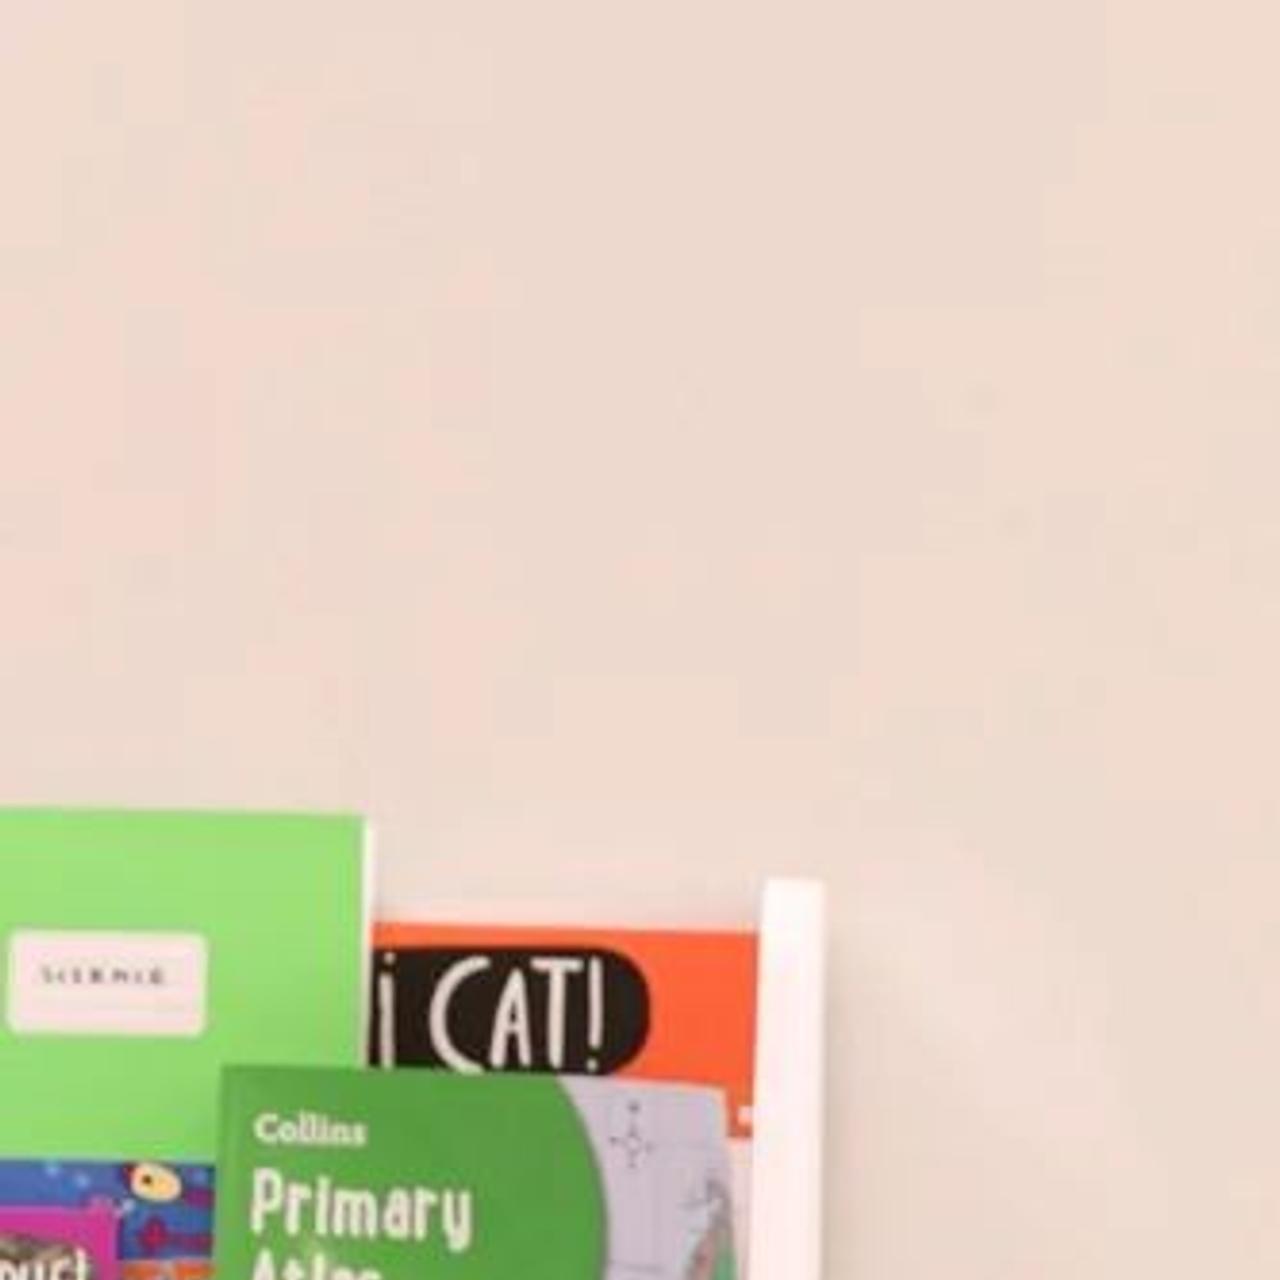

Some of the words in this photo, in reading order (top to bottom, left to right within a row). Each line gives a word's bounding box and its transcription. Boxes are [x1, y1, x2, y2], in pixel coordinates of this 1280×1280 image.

[429, 954, 604, 1074] CAT!
[254, 1111, 368, 1147] Collins
[252, 1167, 472, 1253] Primary
